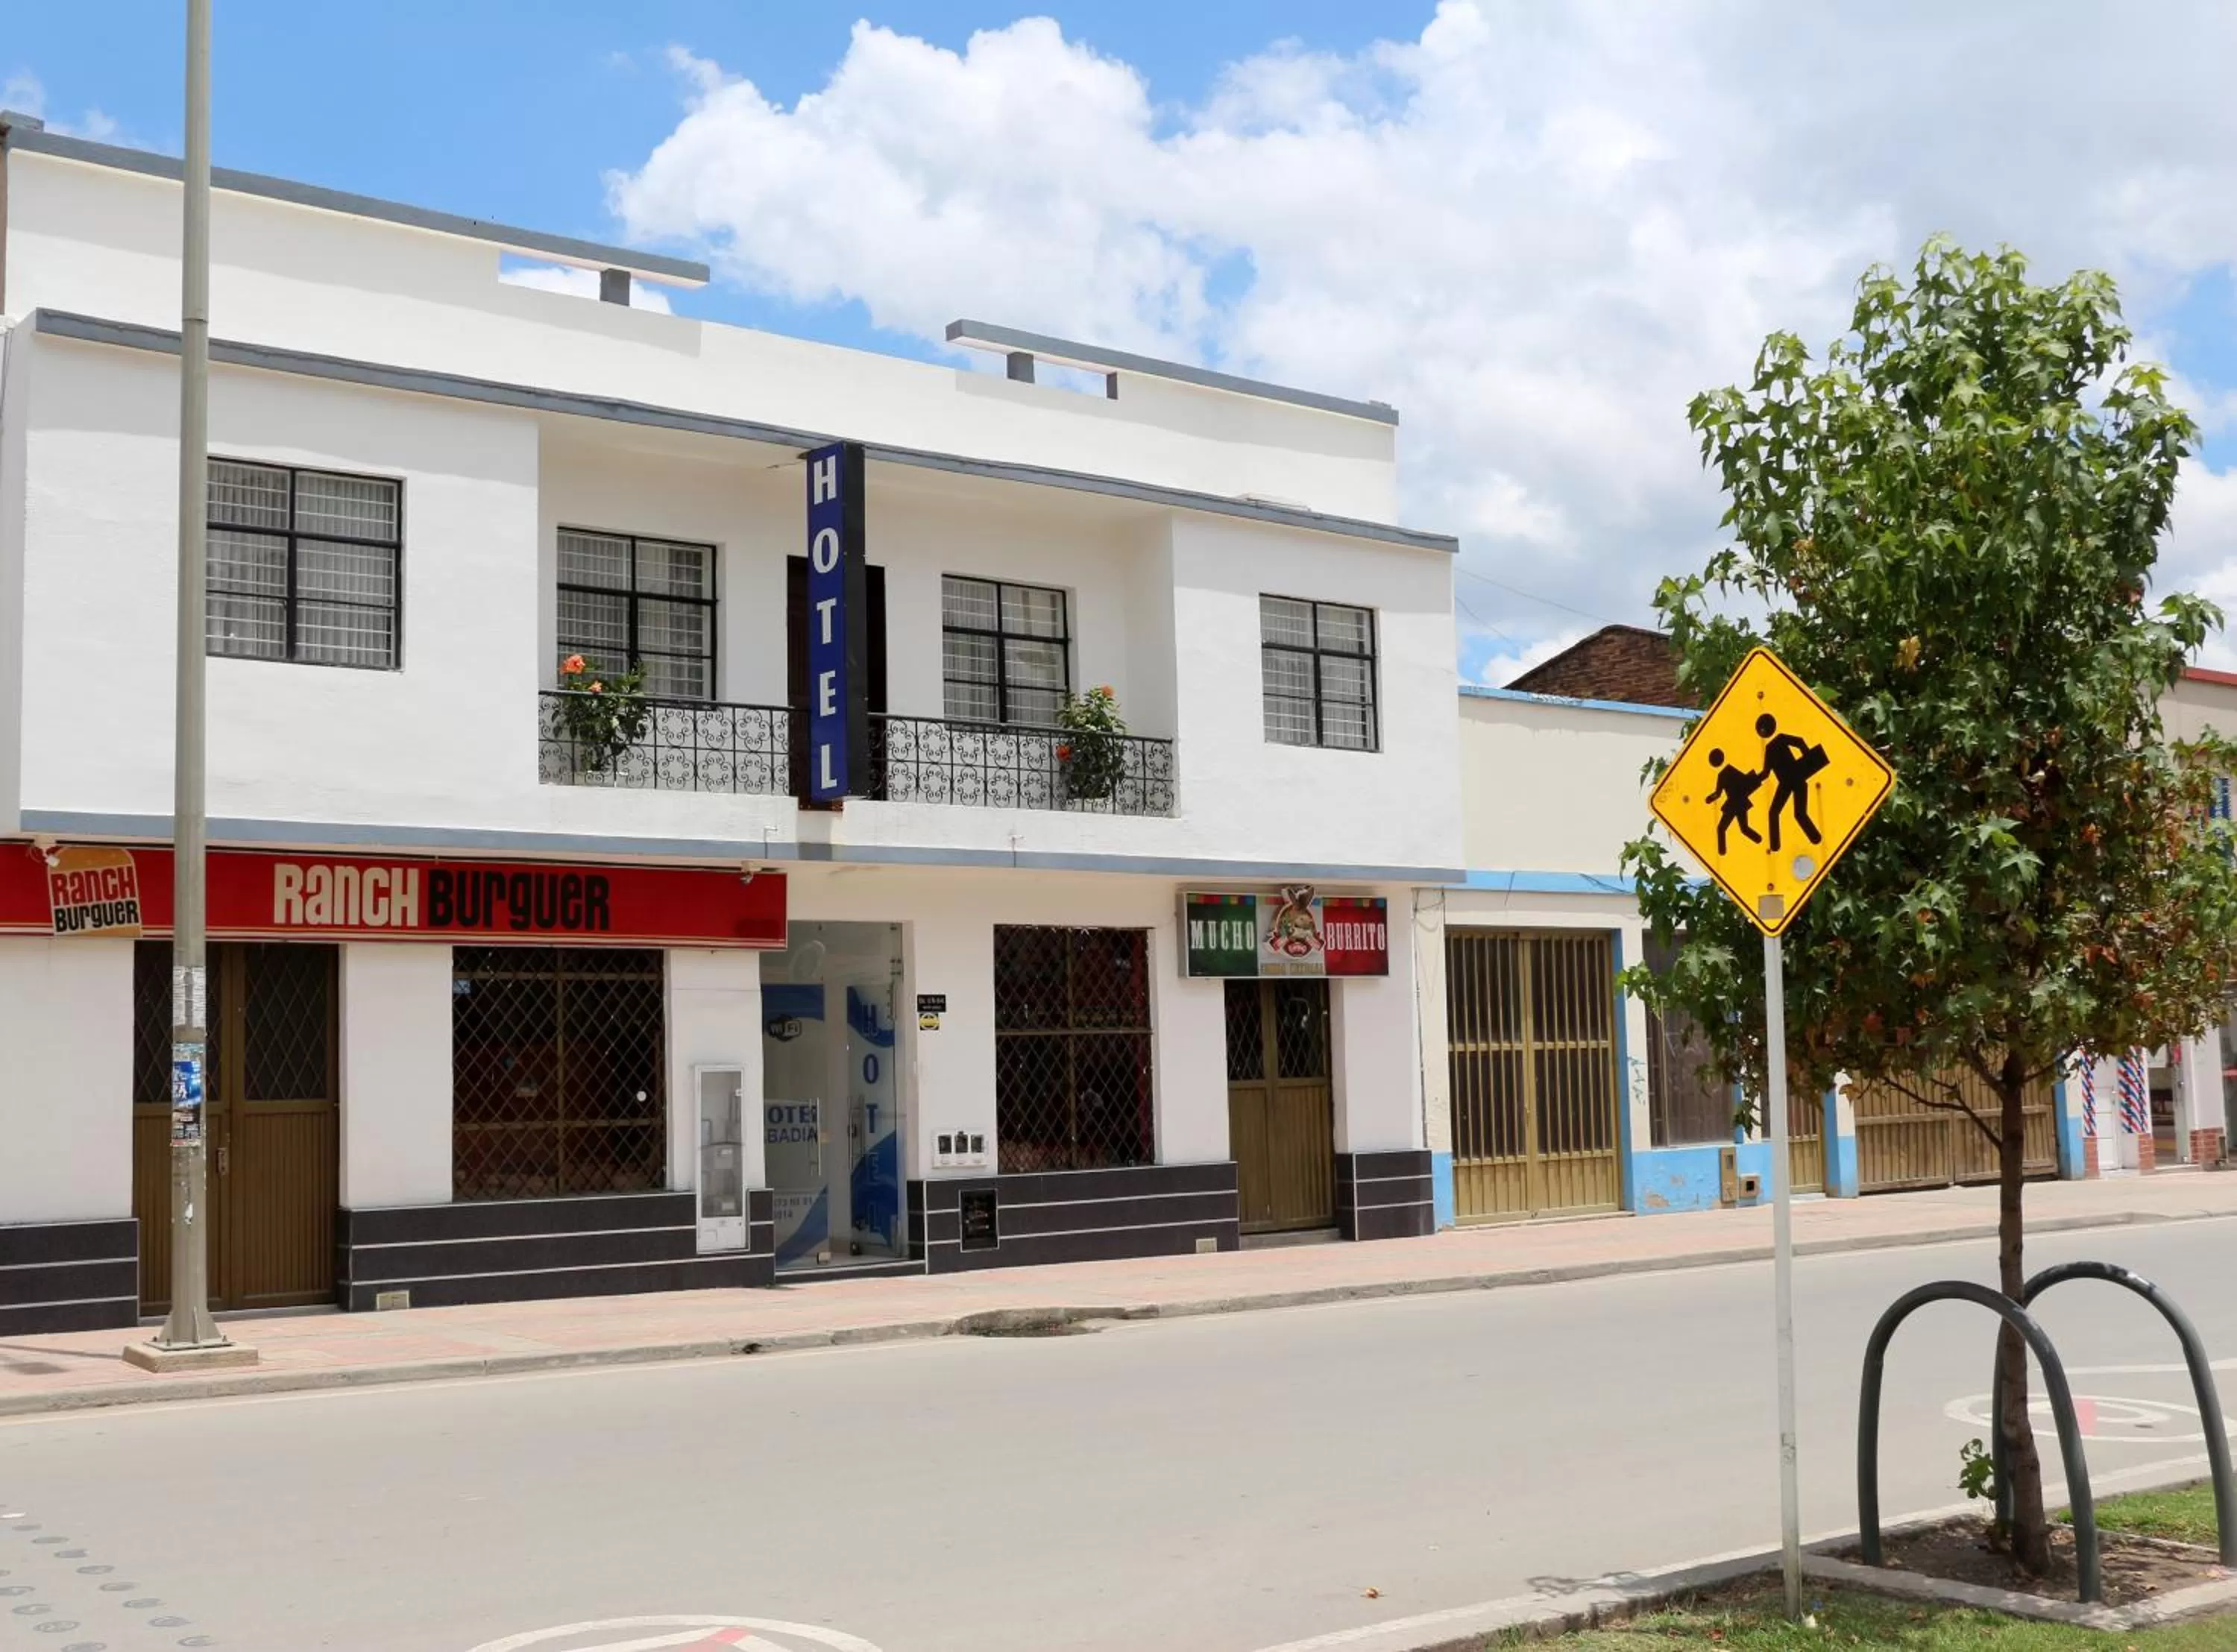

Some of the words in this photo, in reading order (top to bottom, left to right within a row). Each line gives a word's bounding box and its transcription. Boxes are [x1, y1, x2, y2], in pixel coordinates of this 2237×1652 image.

[813, 454, 839, 789] HOTEL
[1191, 920, 1255, 950] MUCHO
[1327, 923, 1385, 950] BURRITO
[862, 1004, 881, 1233] HOTEL
